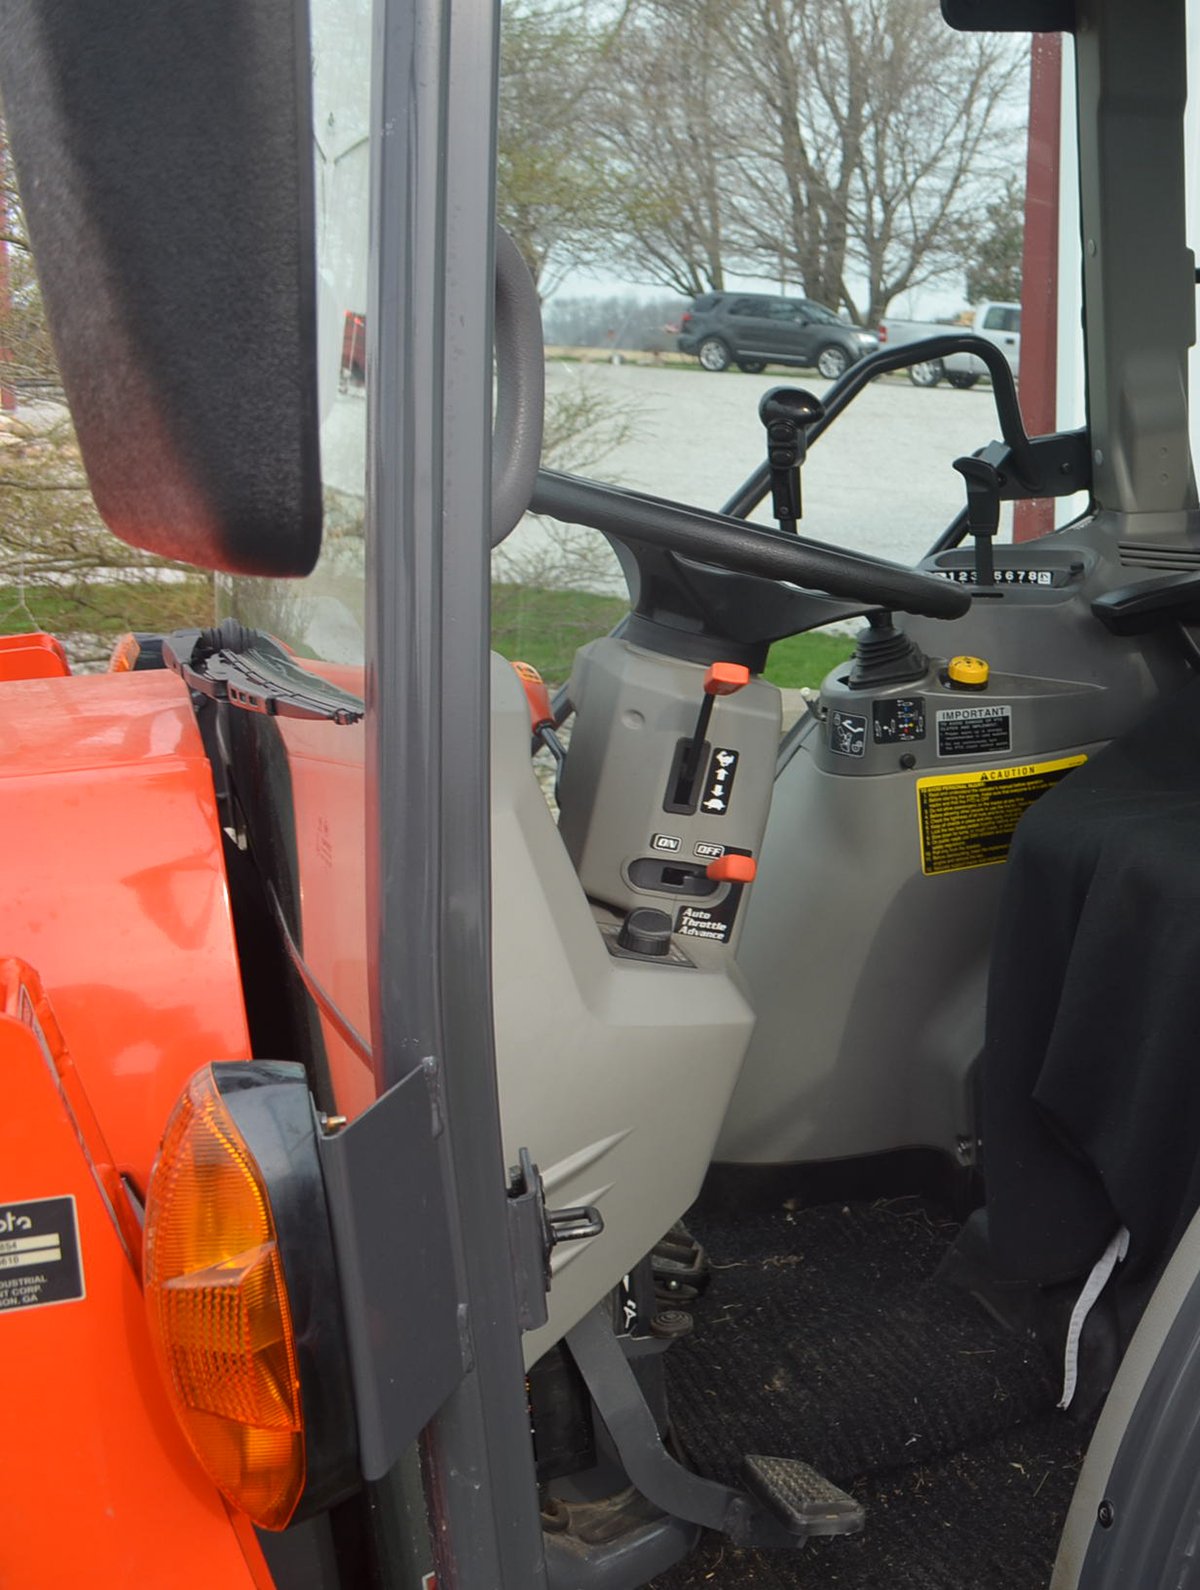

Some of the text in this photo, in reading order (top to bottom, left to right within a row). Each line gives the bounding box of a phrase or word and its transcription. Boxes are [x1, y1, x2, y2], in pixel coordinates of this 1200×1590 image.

[958, 571, 968, 581] 2
[993, 571, 1002, 580] 5
[1005, 571, 1014, 580] 6
[1017, 571, 1025, 580] 7
[1028, 571, 1037, 580] 8
[942, 707, 1005, 720] IMPORTANT
[990, 767, 1035, 780] CAUTION
[658, 838, 678, 849] ON
[697, 845, 722, 856] OFF
[682, 907, 711, 920] Auto
[681, 916, 727, 931] Throttle
[678, 925, 725, 940] Advance
